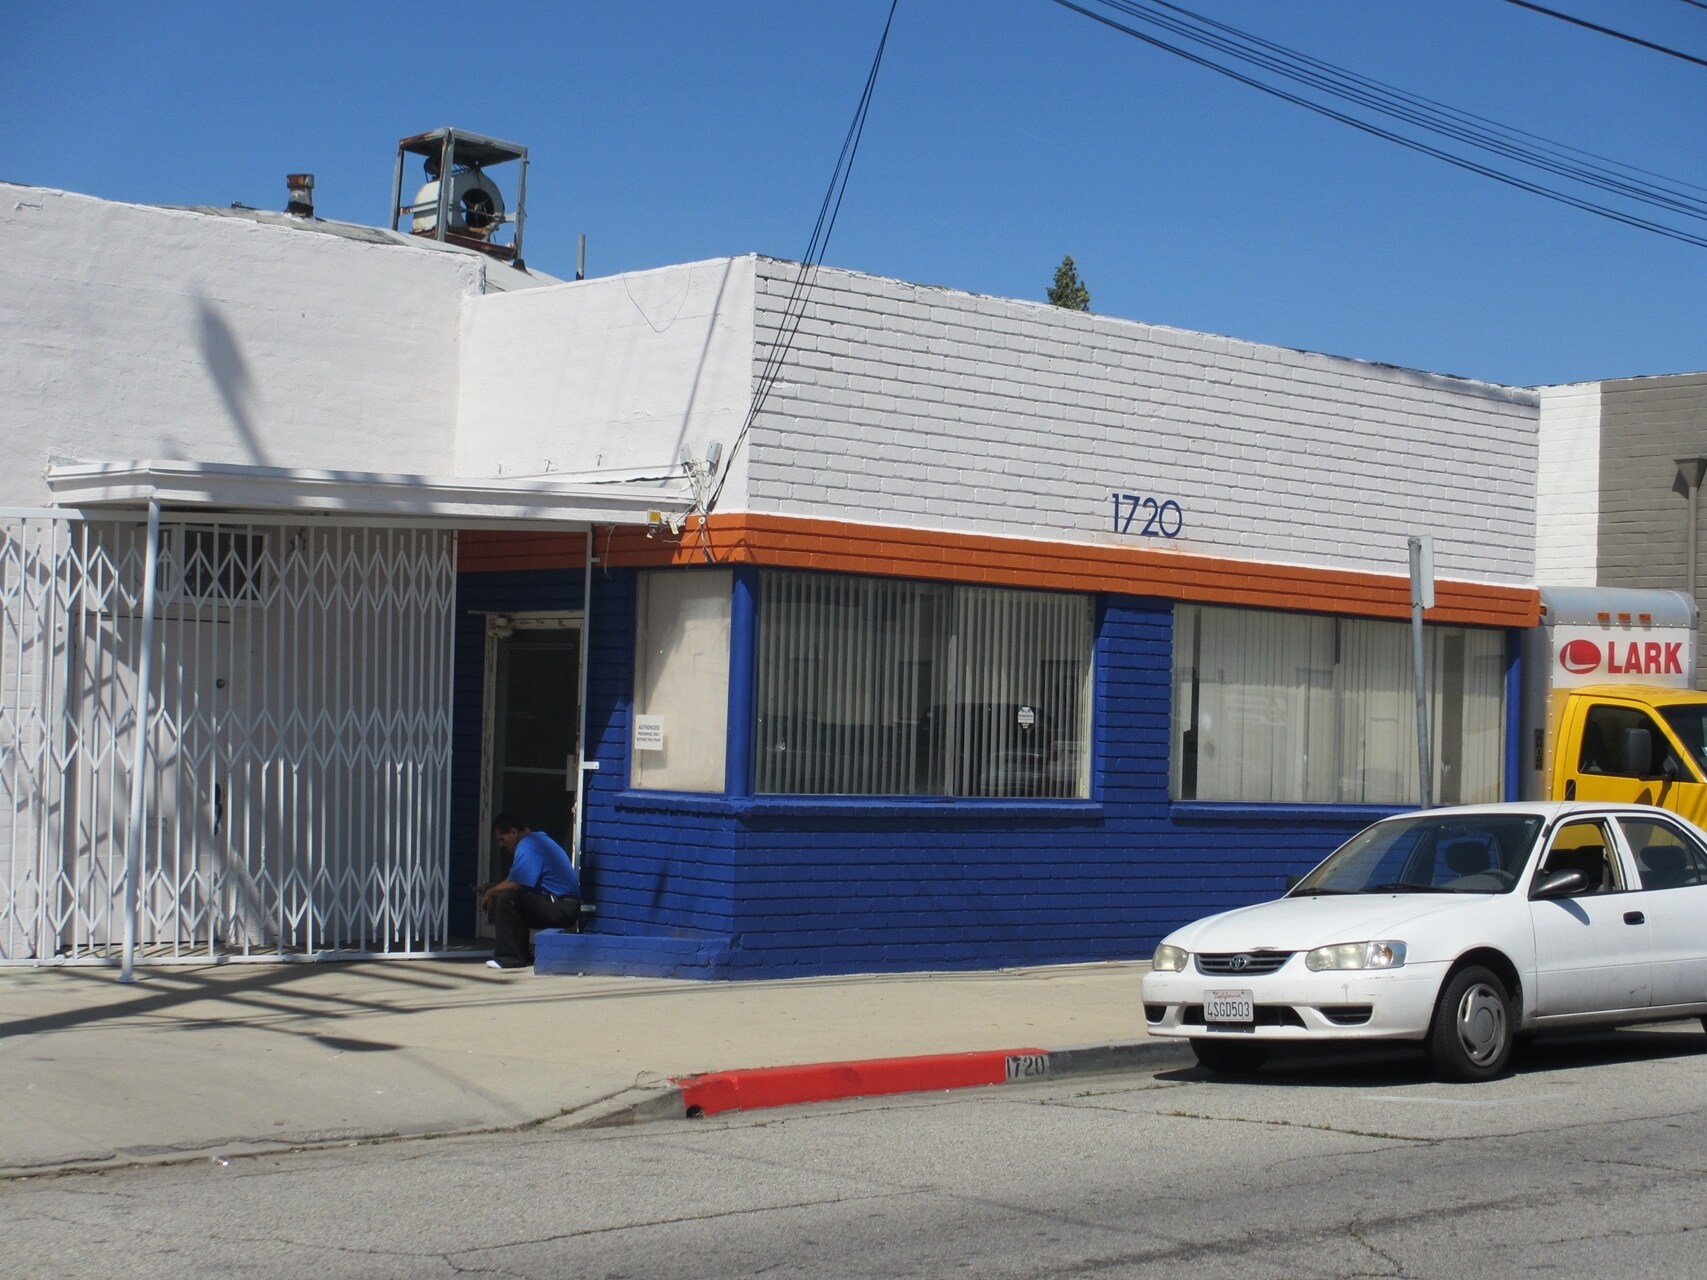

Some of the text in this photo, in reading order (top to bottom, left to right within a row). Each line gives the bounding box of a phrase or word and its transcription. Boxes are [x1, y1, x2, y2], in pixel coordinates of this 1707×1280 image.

[1112, 493, 1182, 538] 1720
[1608, 641, 1683, 674] LARK
[1207, 1001, 1250, 1017] 4SGD503
[1006, 1055, 1045, 1079] 1720
